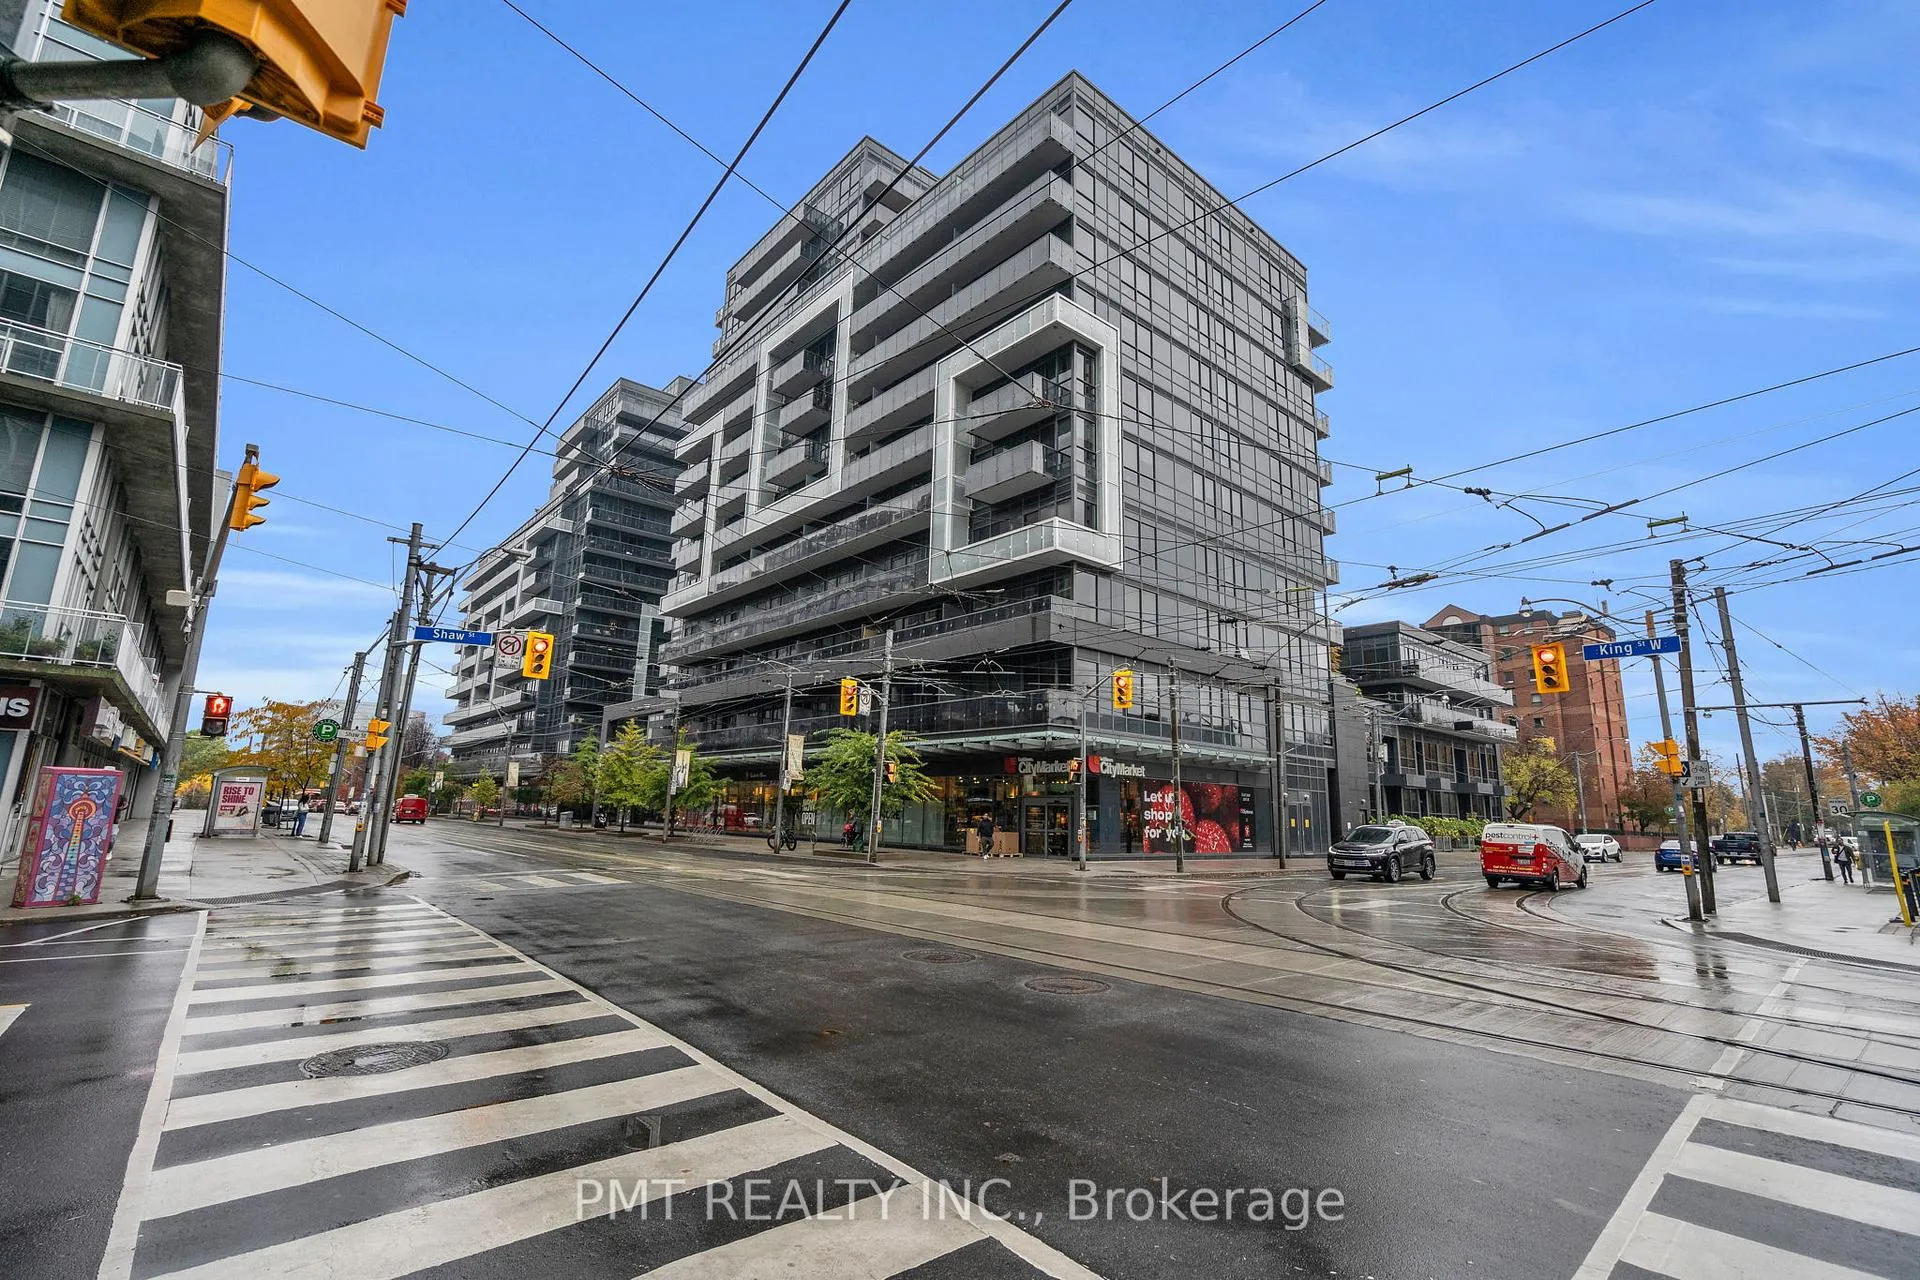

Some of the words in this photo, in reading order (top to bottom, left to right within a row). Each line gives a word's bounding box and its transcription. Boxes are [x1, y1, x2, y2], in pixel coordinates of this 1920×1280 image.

[433, 628, 465, 640] Shaw
[1600, 644, 1633, 656] King
[1649, 639, 1661, 650] W
[1100, 761, 1146, 778] CityMarket
[223, 786, 242, 795] RISE
[244, 786, 255, 795] TO
[1144, 790, 1162, 803] Let
[1144, 808, 1173, 823] shop
[1831, 805, 1848, 814] 30
[1144, 825, 1162, 839] for
